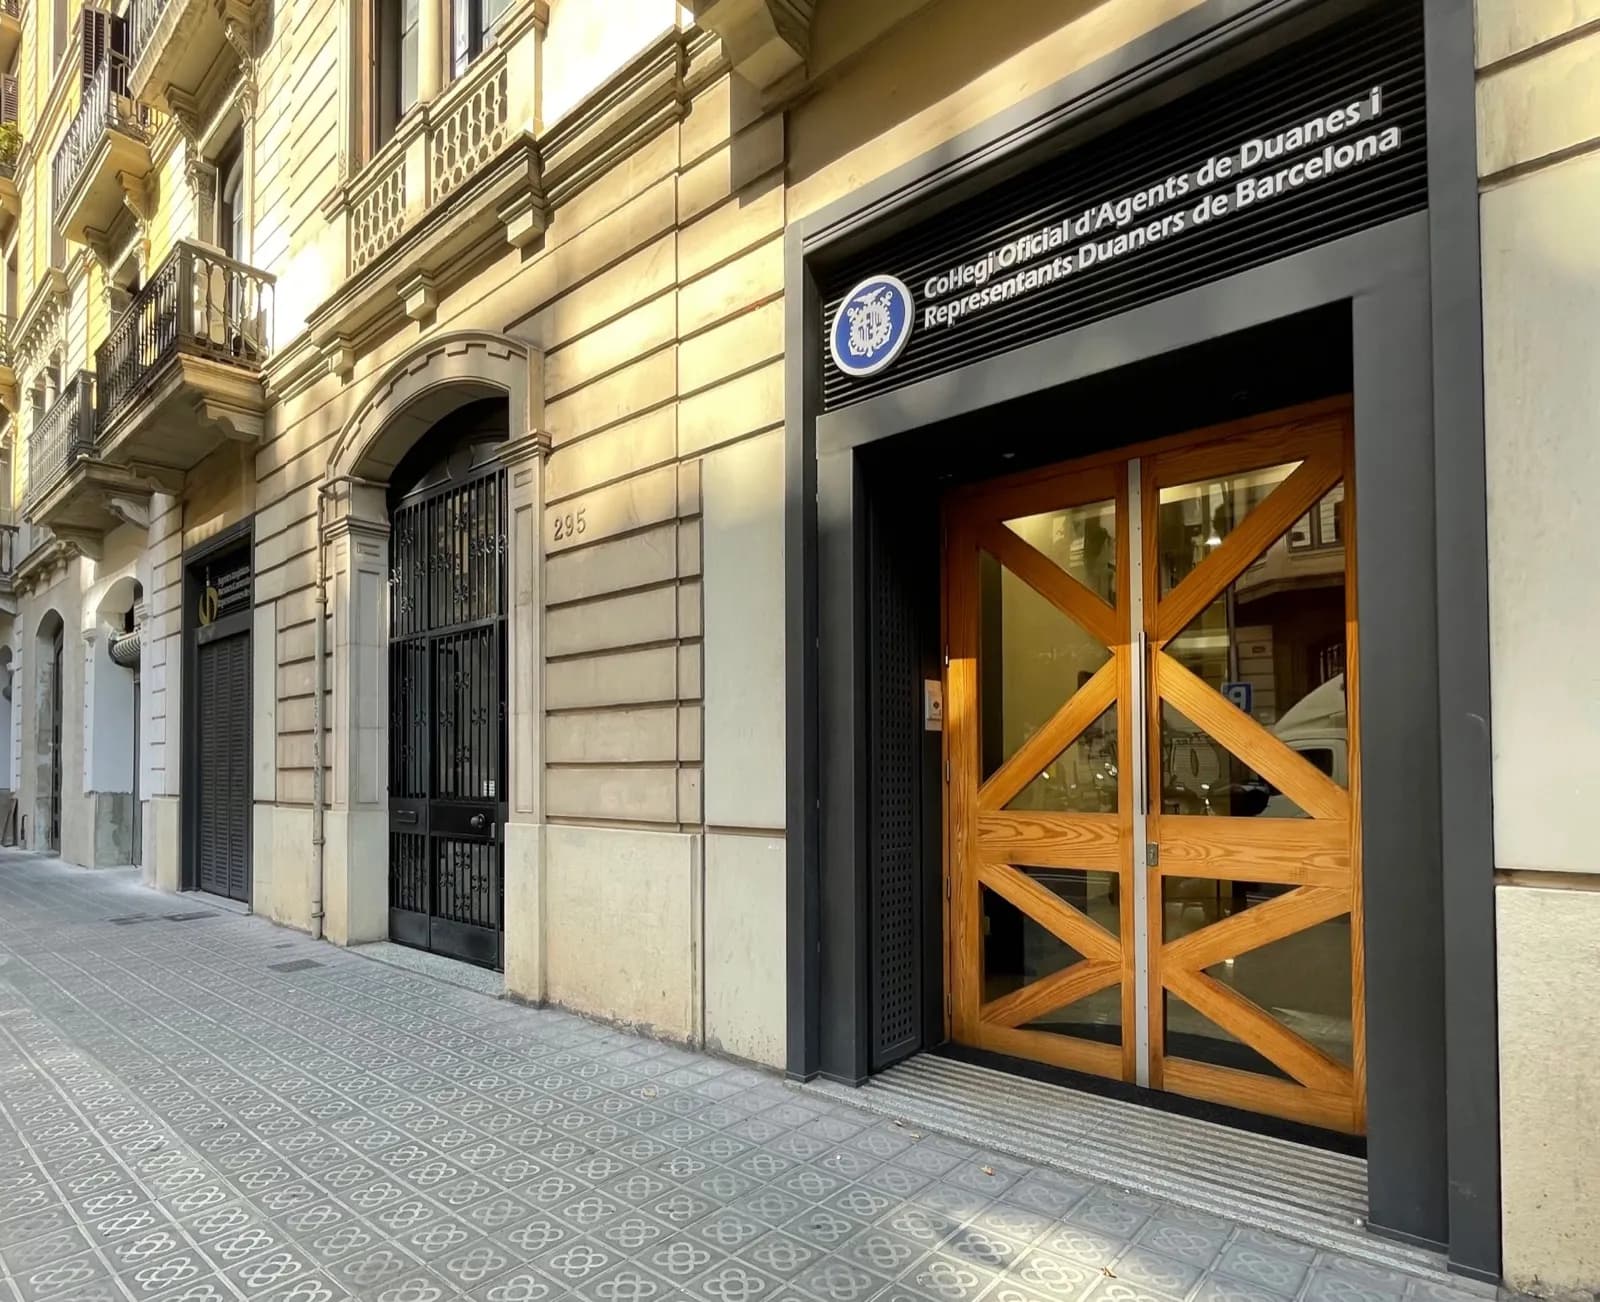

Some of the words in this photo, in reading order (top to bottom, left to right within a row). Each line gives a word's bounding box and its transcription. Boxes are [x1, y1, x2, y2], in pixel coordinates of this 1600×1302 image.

[924, 255, 1073, 329] Representants
[1078, 211, 1185, 269] Duaners
[1192, 194, 1228, 225] de
[1236, 126, 1399, 208] Barcelona
[999, 219, 1069, 268] Oficial
[1075, 173, 1190, 236] d'Agents
[1196, 157, 1232, 187] de
[1241, 102, 1361, 169] Duanes
[1370, 85, 1381, 116] i
[553, 507, 586, 541] 295
